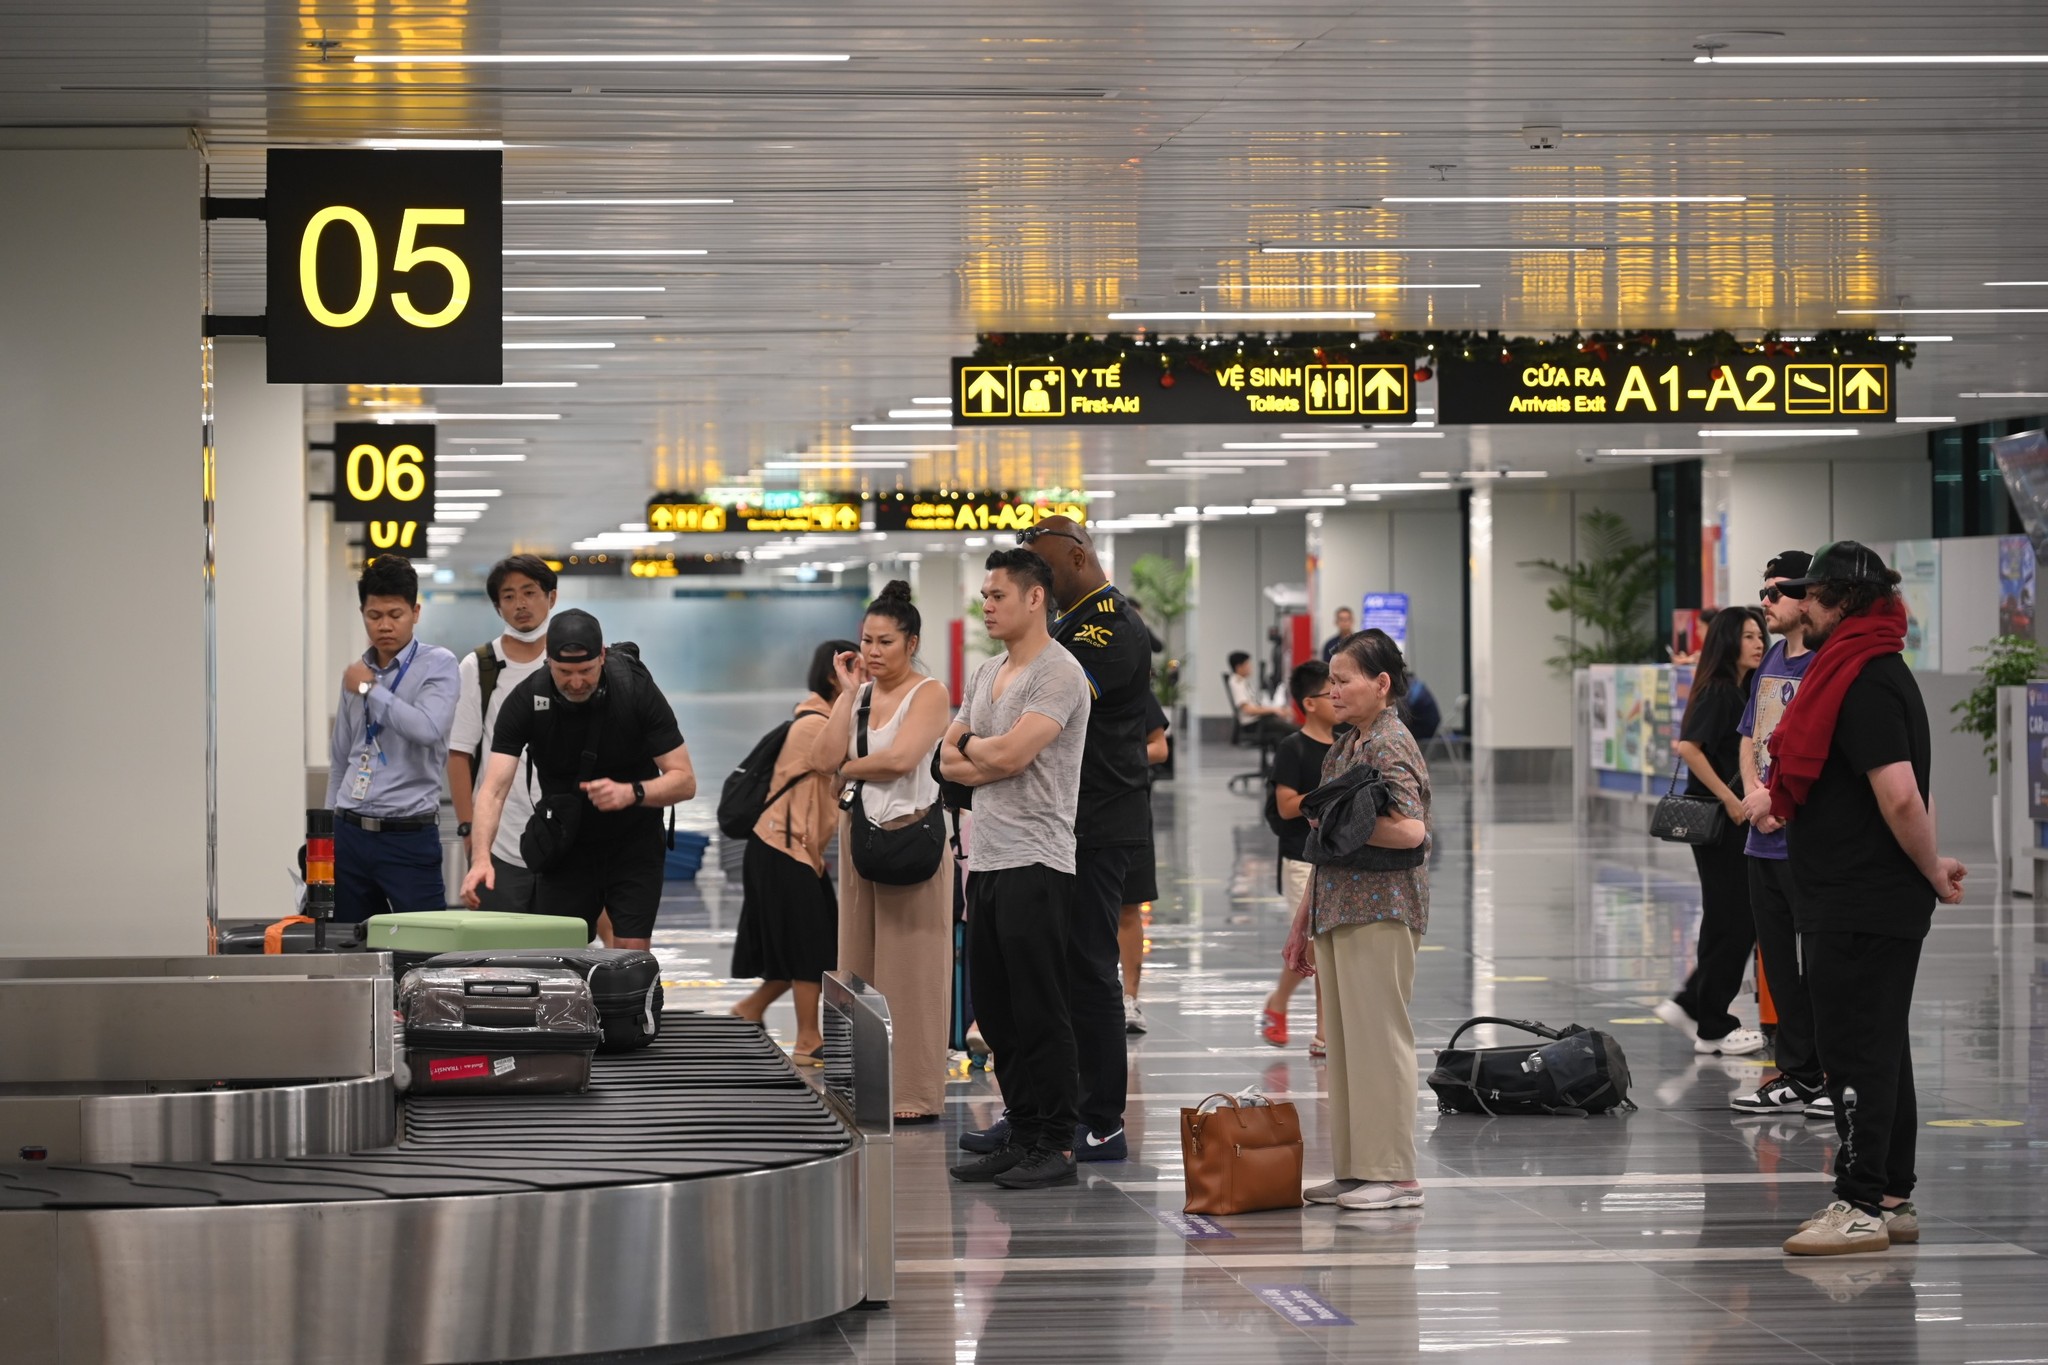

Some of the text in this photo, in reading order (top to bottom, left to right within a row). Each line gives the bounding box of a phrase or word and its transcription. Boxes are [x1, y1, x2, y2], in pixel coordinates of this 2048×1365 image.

[299, 205, 471, 329] 05
[1071, 362, 1121, 388] Y TẾ
[1215, 363, 1302, 392] VỆ SINH
[1522, 362, 1606, 388] CỬA RA
[1614, 364, 1776, 412] A1-A2
[1070, 395, 1140, 414] First-Aid
[1246, 394, 1300, 413] Toilets
[1508, 395, 1607, 413] Arrivals Exit
[346, 444, 425, 502] 06
[954, 503, 1034, 530] A1-A2
